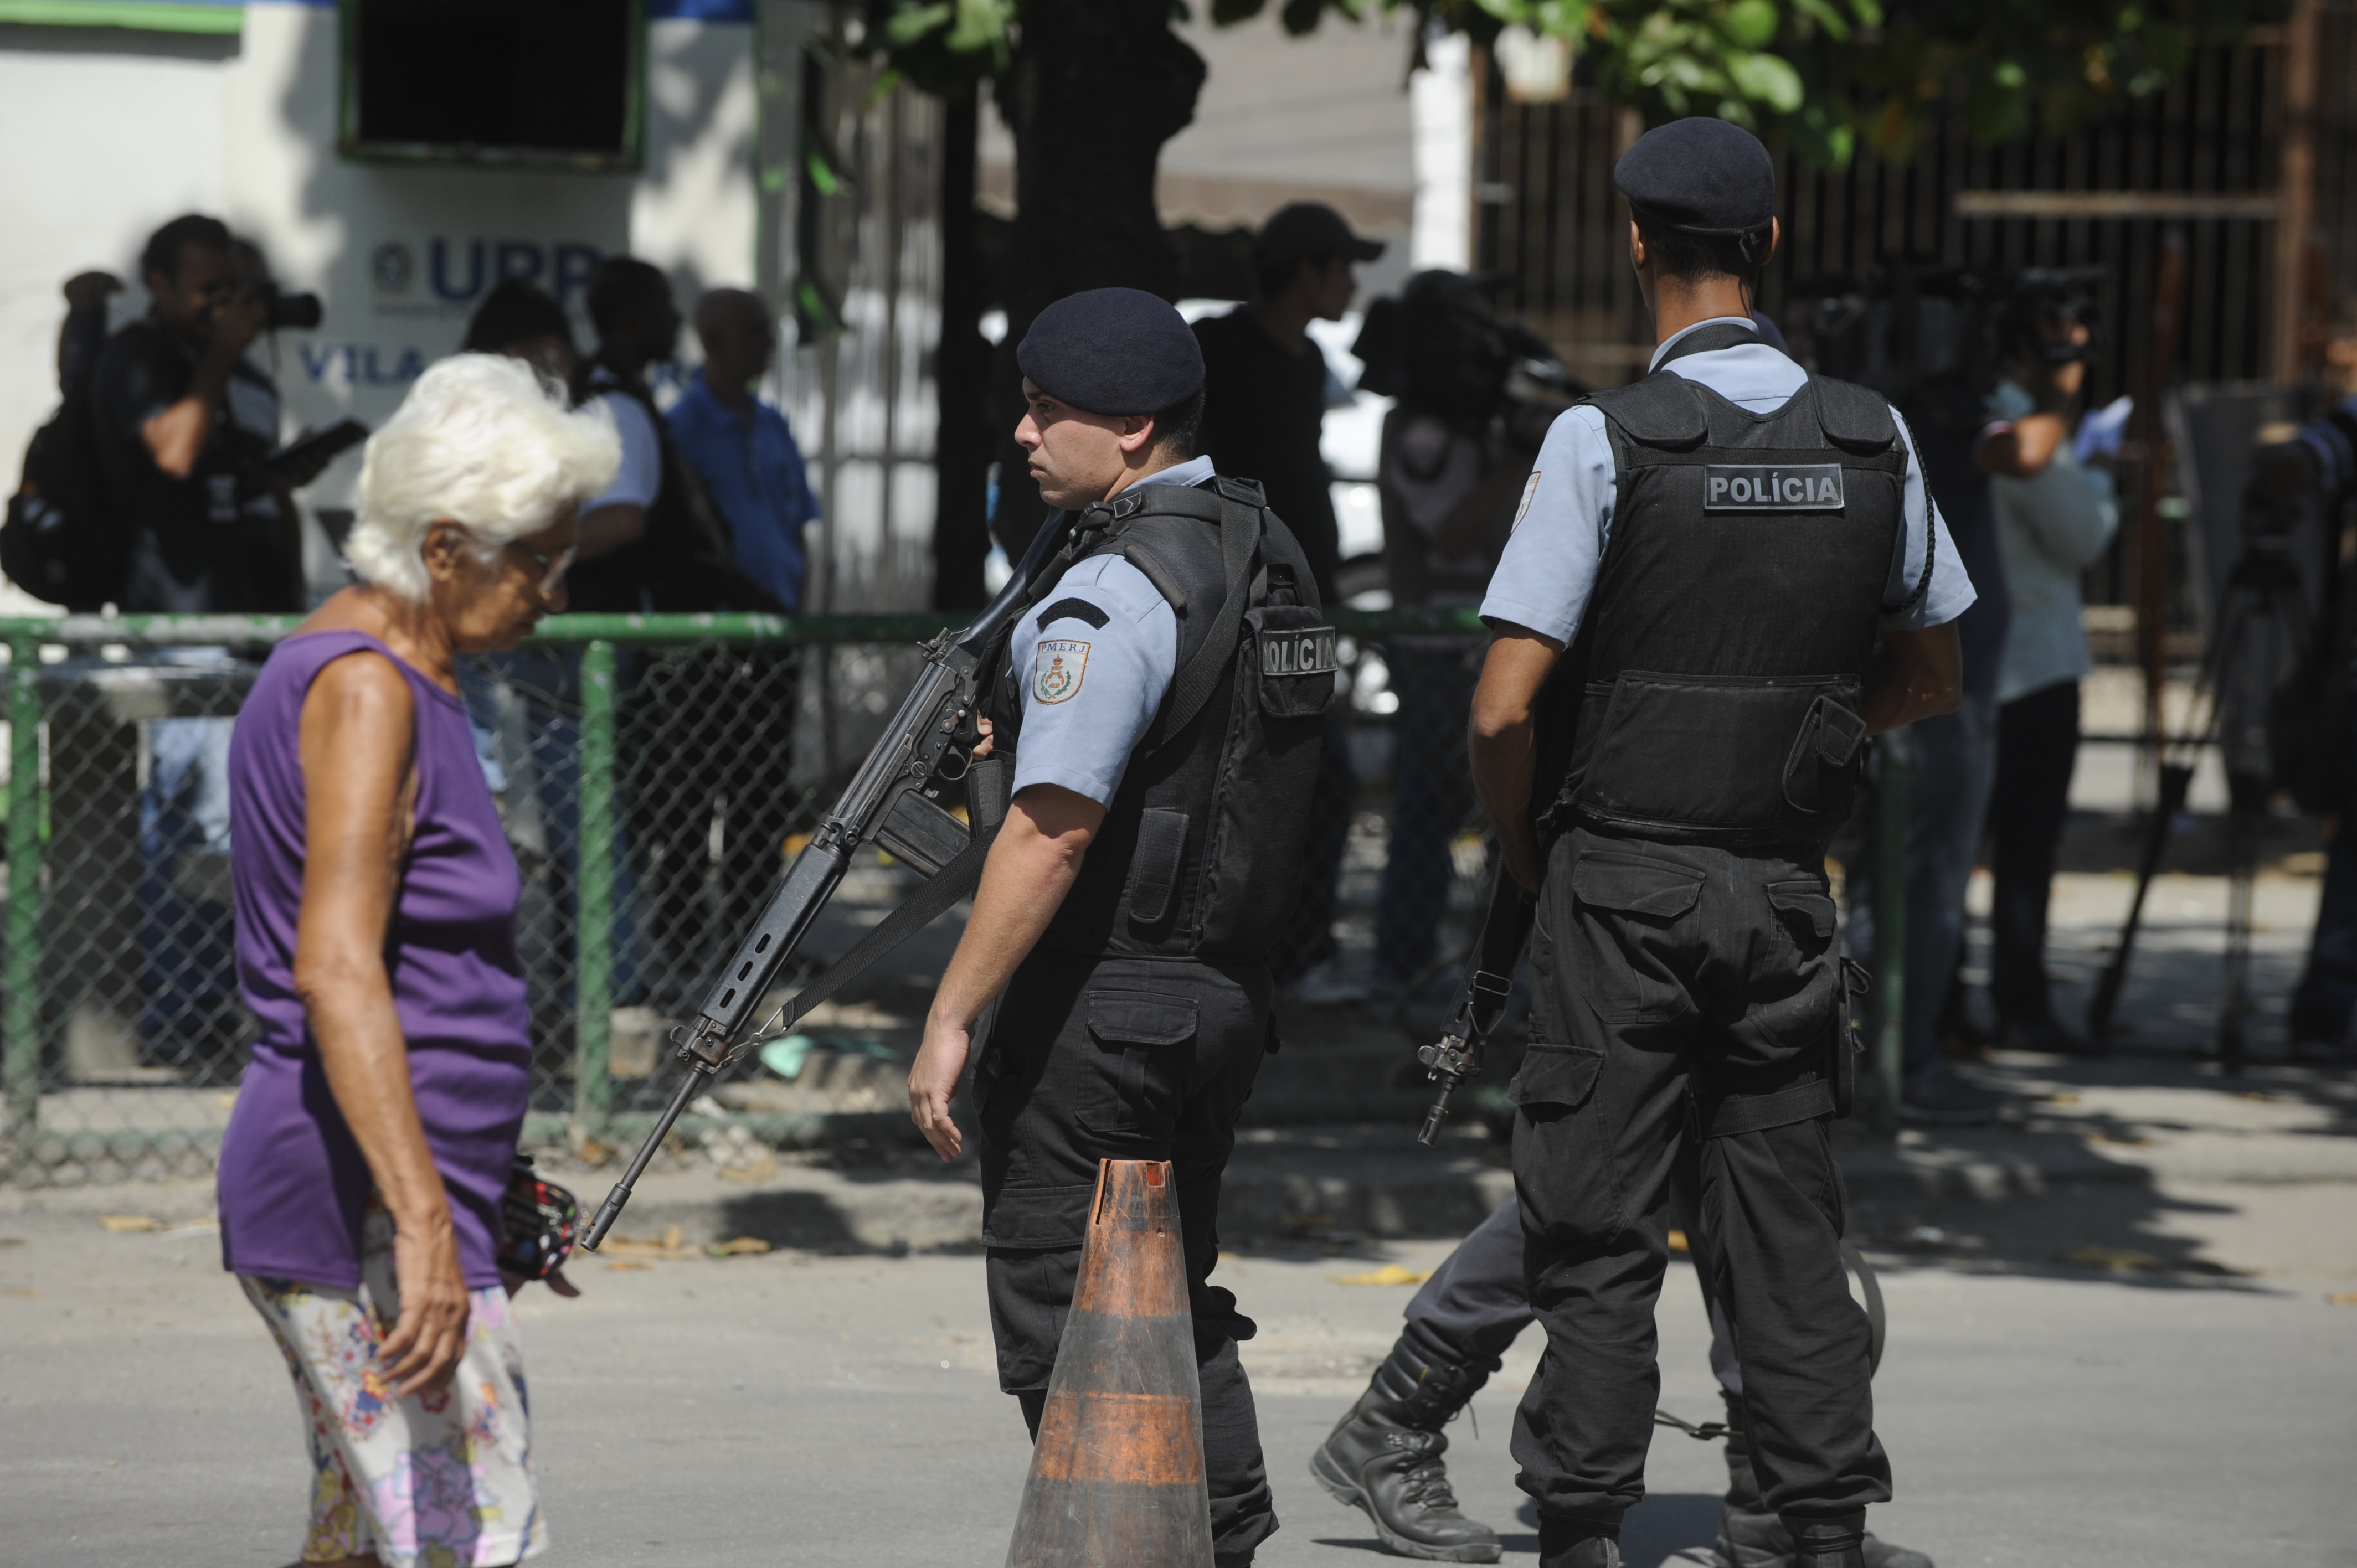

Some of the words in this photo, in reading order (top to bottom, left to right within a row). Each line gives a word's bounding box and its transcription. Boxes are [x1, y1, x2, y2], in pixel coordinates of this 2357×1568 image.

[302, 344, 424, 383] VILA
[1710, 472, 1840, 502] POLÍCIA
[1041, 643, 1085, 652] PMERJ
